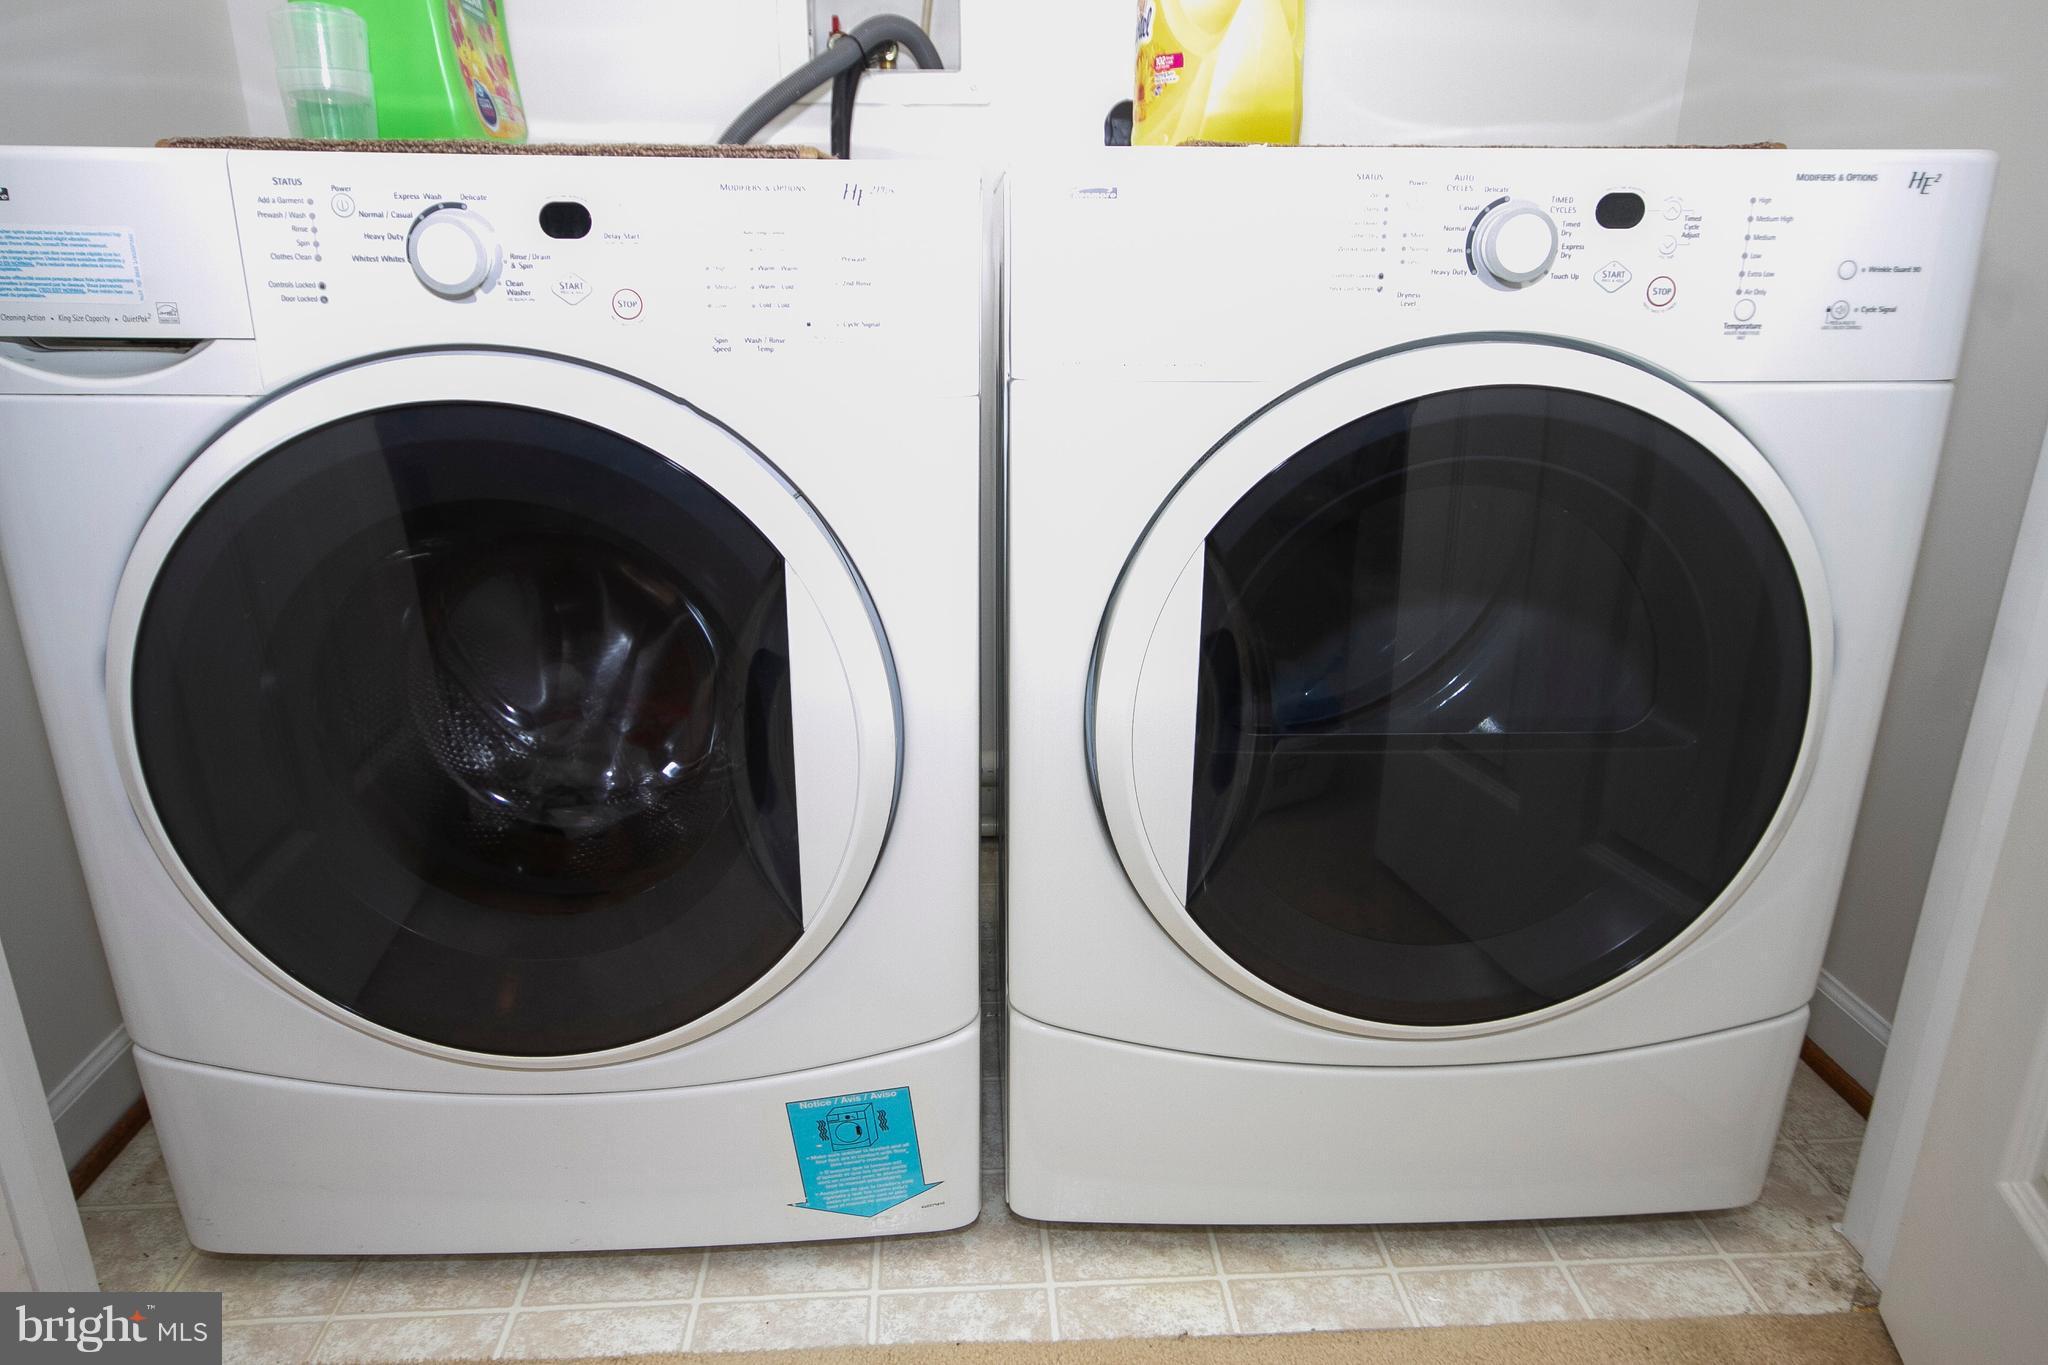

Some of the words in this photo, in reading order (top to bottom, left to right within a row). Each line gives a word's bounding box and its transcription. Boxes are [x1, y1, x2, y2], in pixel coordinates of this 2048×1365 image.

[272, 176, 303, 186] STATUS
[1796, 173, 1836, 182] MODIFIERS
[1846, 174, 1878, 182] OPTIONS
[330, 184, 352, 193] Power
[257, 196, 270, 204] Add
[277, 196, 304, 204] Garment
[393, 192, 420, 200] Express
[423, 192, 442, 200] Wash
[459, 193, 488, 201] Delicate
[256, 210, 283, 218] Prewash
[288, 210, 306, 218] Wash
[358, 210, 384, 218] Normal
[391, 211, 413, 219] Casual
[363, 233, 385, 241] Heavy
[388, 233, 404, 241] Duty
[296, 239, 310, 247] Spin
[518, 263, 534, 271] Spin
[1570, 273, 1580, 281] Up
[1602, 271, 1626, 279] START
[559, 282, 584, 290] START
[506, 289, 532, 297] Washer
[1652, 287, 1672, 295] STOP
[617, 300, 638, 308] STOP
[58, 314, 71, 323] King
[72, 314, 84, 322] Size
[85, 315, 110, 323] Capacity
[1723, 322, 1762, 330] Temperature
[800, 1100, 832, 1110] Notice
[840, 1095, 862, 1104] Avis
[870, 1091, 897, 1100] Aviso
